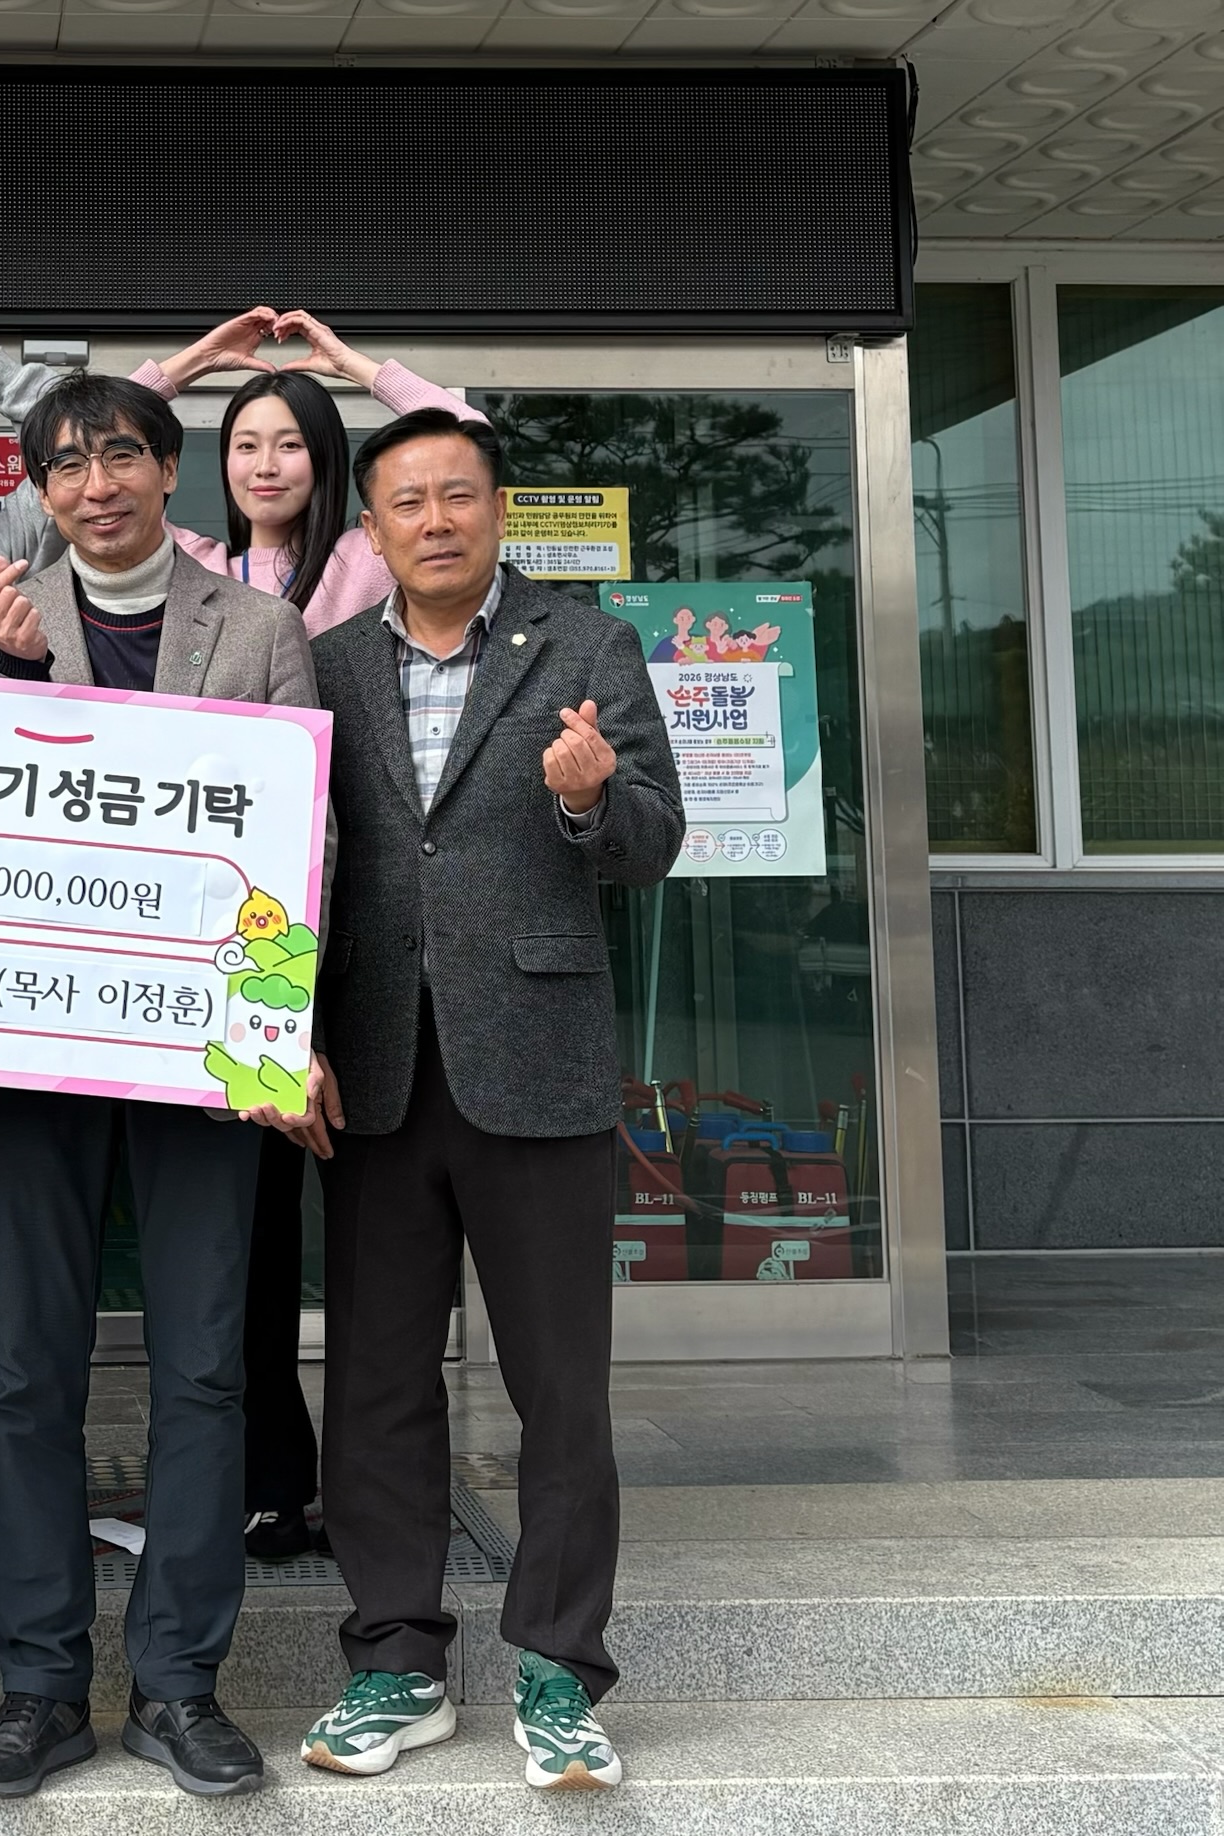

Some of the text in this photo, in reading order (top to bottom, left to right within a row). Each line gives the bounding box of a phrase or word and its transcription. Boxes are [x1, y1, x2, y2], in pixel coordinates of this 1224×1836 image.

[517, 495, 540, 504] CCTV
[558, 495, 567, 504] 및
[567, 495, 583, 504] 운영
[678, 672, 739, 682] 2026 경상남도
[666, 684, 755, 708] 손주돌봄
[670, 708, 748, 732] 지원사업
[48, 767, 146, 826] 성금
[155, 779, 254, 838] 기탁
[97, 978, 215, 1030] 이정훈)
[797, 1192, 838, 1205] BL-11
